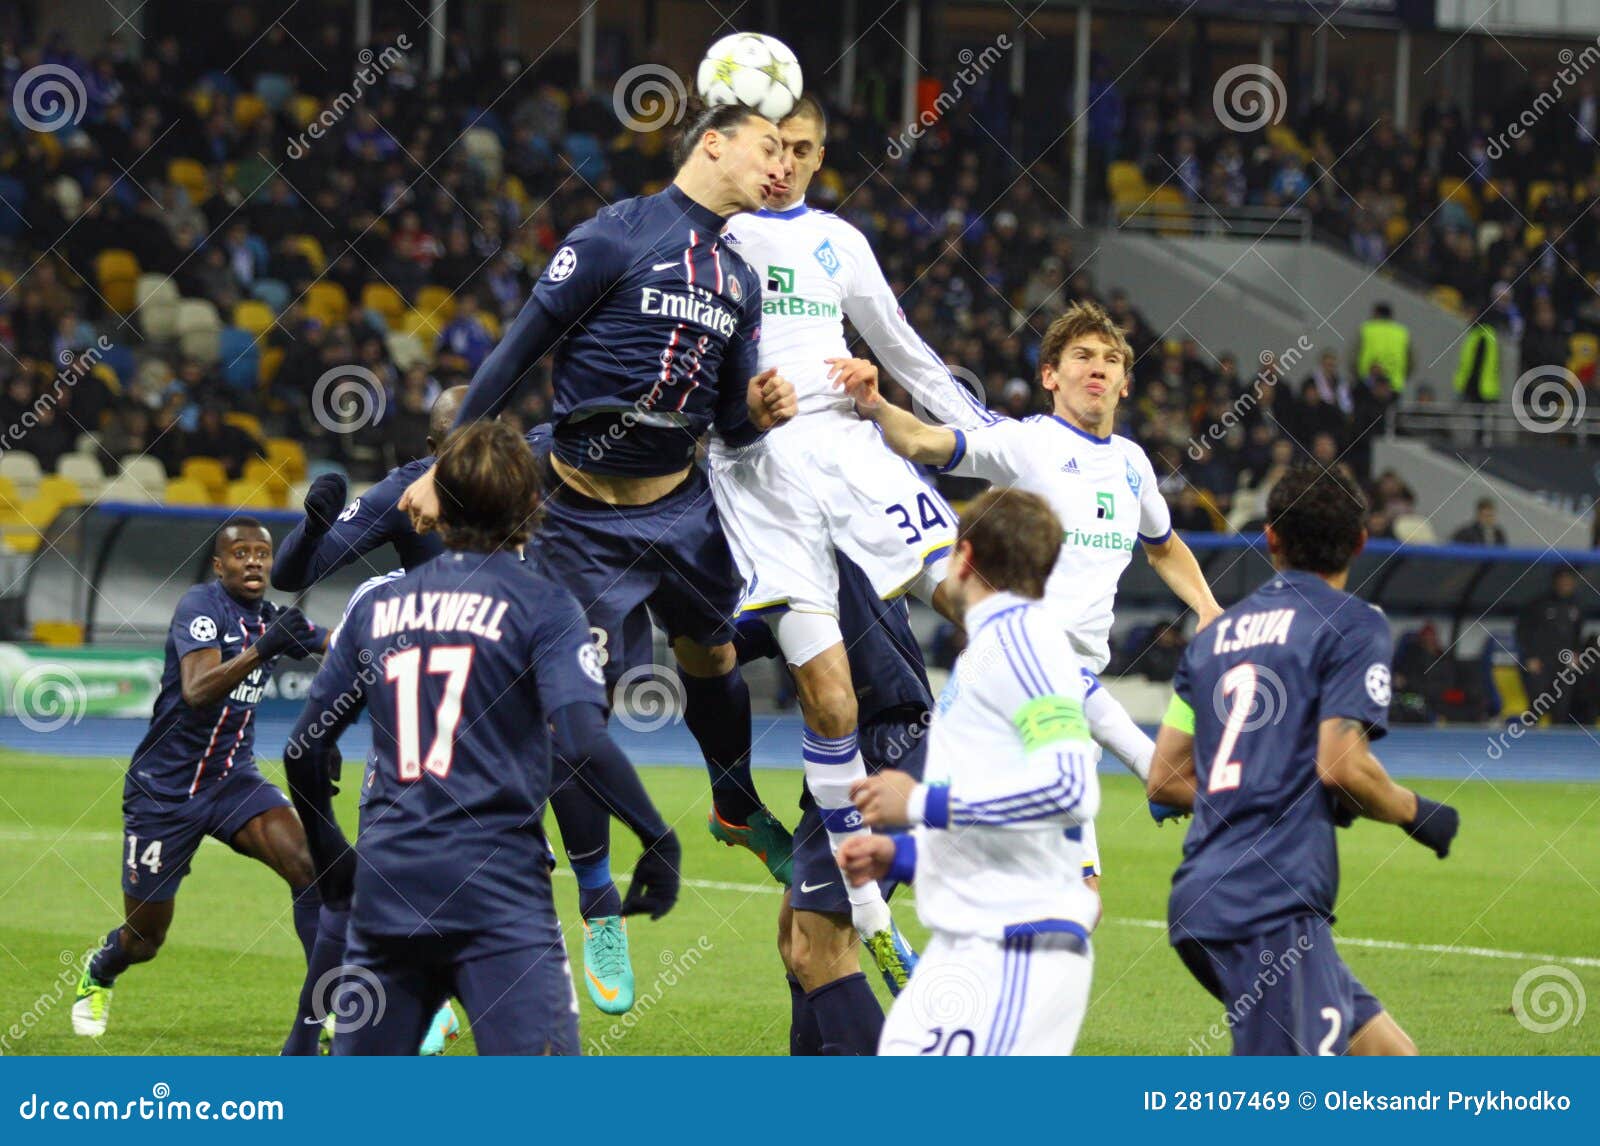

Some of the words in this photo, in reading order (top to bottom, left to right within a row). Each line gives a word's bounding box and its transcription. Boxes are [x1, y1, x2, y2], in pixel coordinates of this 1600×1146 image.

[641, 287, 738, 338] Emirates
[885, 492, 949, 545] 34
[372, 592, 509, 642] MAXWELL
[1213, 608, 1297, 656] T.SILVA
[384, 644, 475, 785] 17
[1207, 661, 1257, 796] 2
[126, 835, 163, 874] 14
[1317, 1006, 1342, 1056] 2
